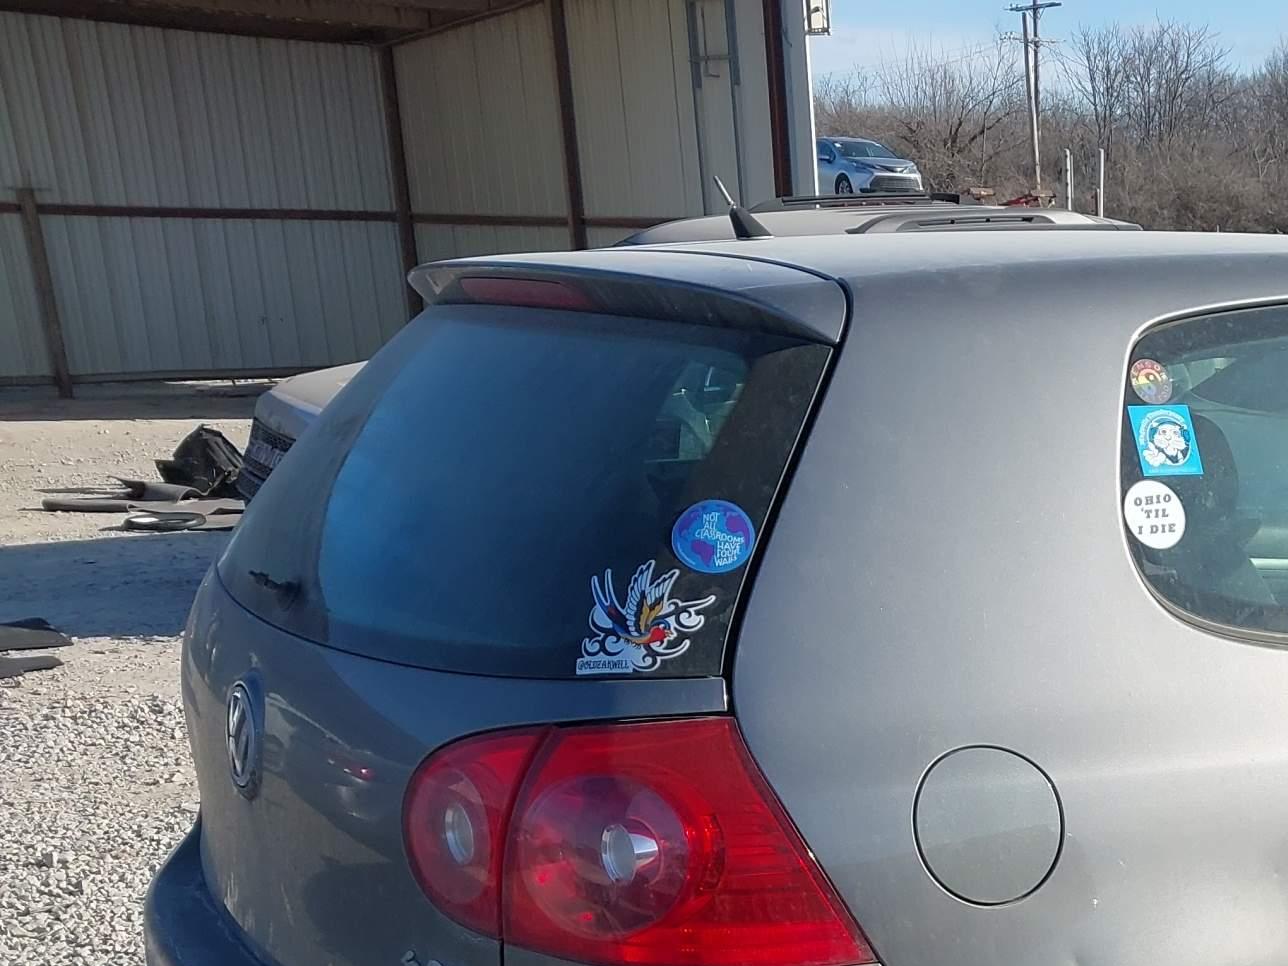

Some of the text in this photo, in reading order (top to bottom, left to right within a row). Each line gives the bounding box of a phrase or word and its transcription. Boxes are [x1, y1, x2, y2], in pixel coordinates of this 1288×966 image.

[1133, 493, 1172, 507] OHIO
[703, 511, 721, 523] NOT
[703, 522, 717, 531] ALL
[1137, 523, 1176, 535] I DIE
[695, 529, 745, 545] CLASSROOMS
[717, 541, 742, 551] HAVE
[713, 555, 737, 567] WALLS
